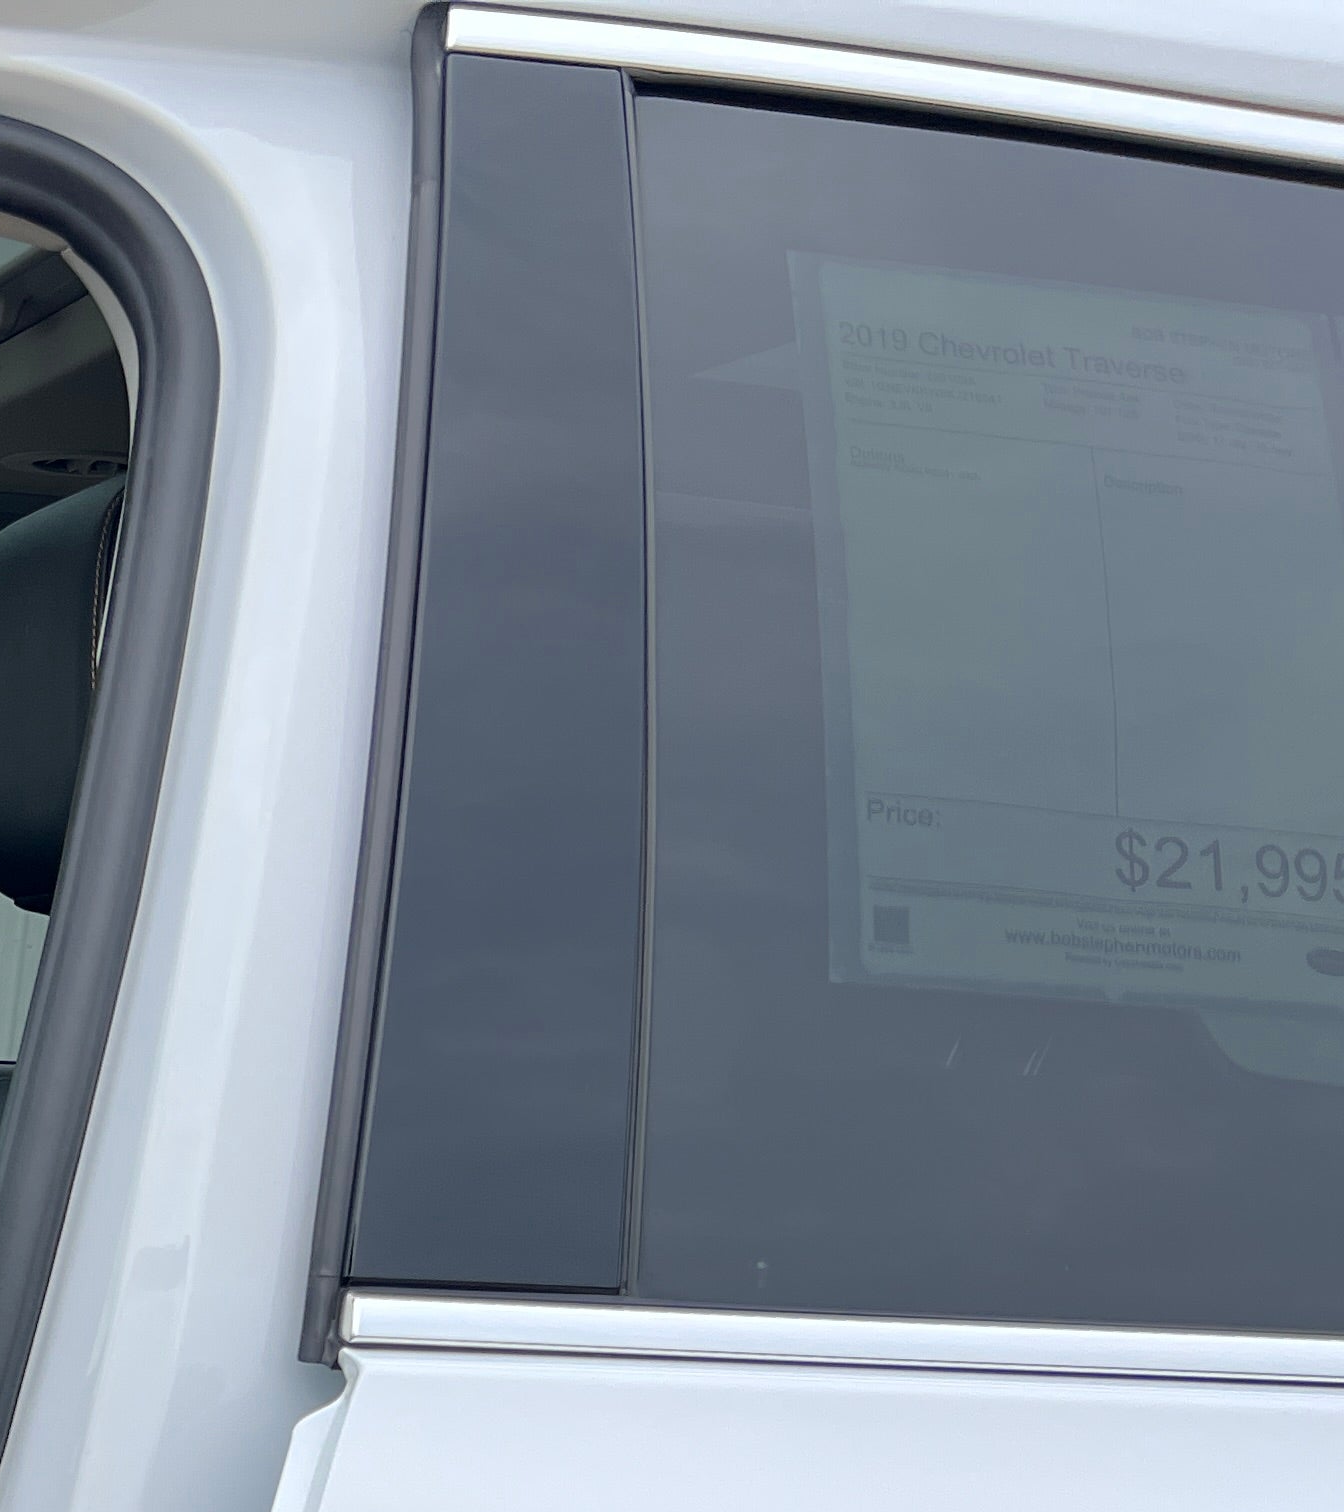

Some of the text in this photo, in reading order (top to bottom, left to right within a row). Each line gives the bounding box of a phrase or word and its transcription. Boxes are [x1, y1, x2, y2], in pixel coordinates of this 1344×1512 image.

[839, 322, 1186, 383] 2019 Chevrolet Traverse
[867, 799, 941, 829] Price:
